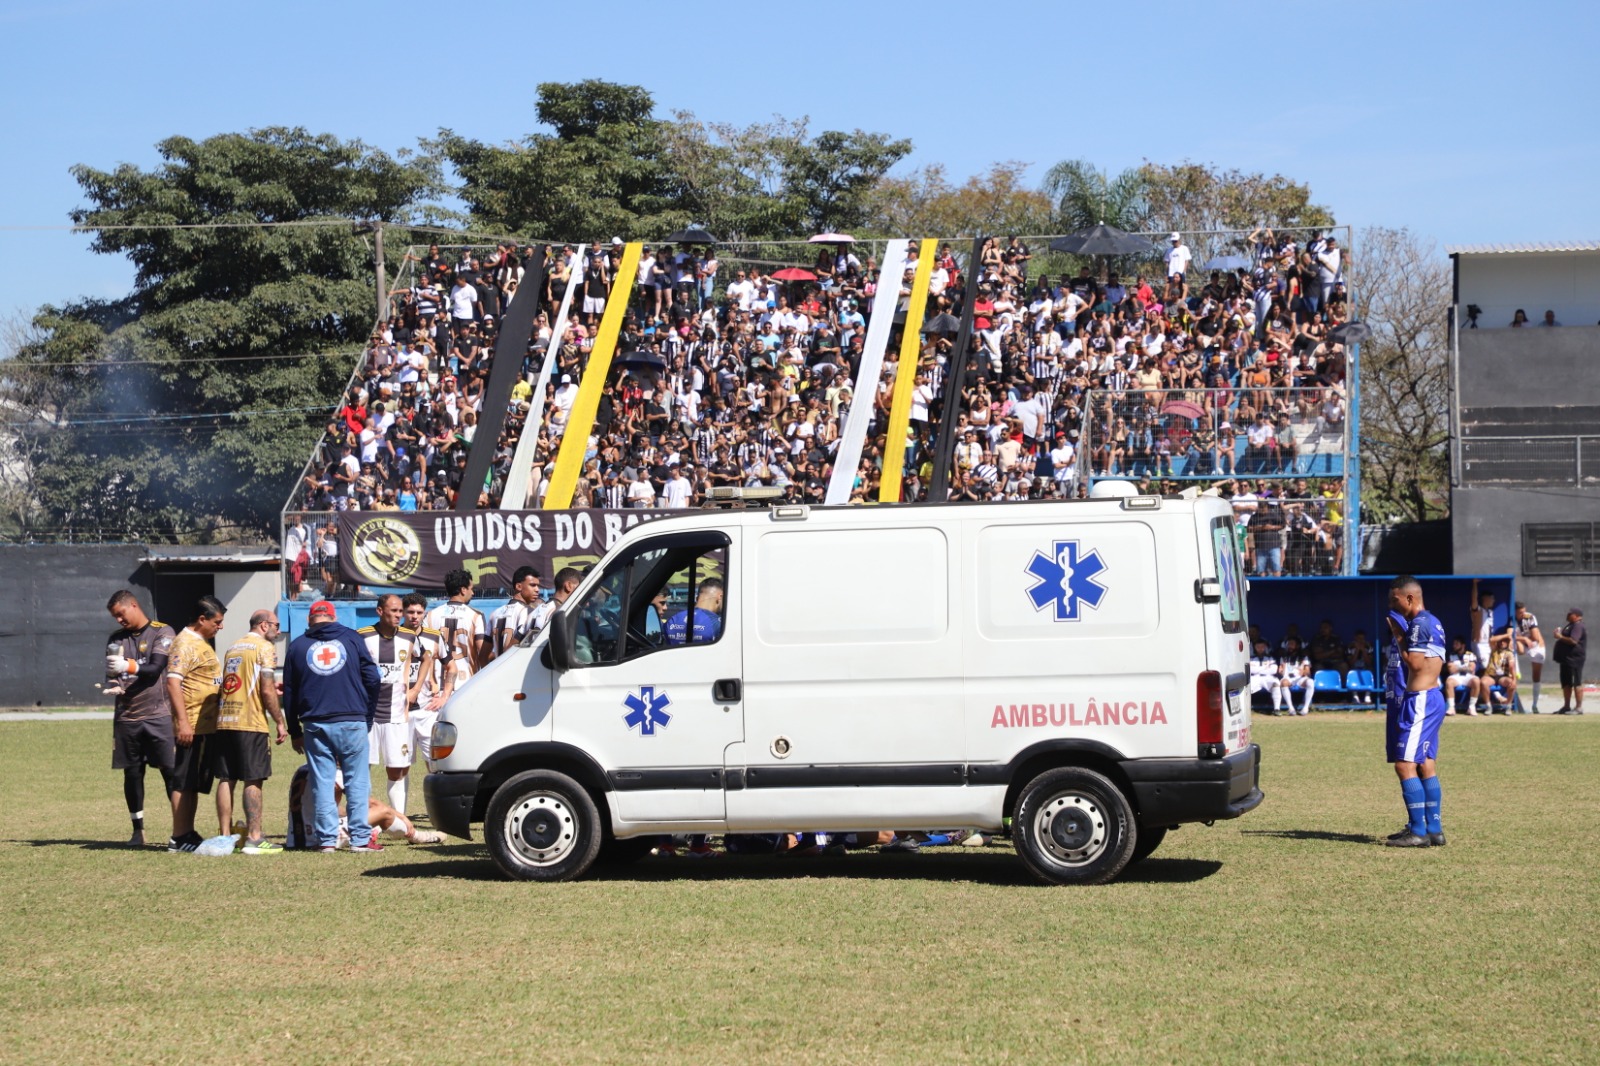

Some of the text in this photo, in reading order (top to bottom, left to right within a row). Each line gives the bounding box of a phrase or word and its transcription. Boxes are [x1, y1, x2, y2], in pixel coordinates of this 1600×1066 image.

[434, 512, 542, 554] UNIDOS
[554, 511, 593, 550] DO
[990, 697, 1168, 728] AMBULÂNCIA
